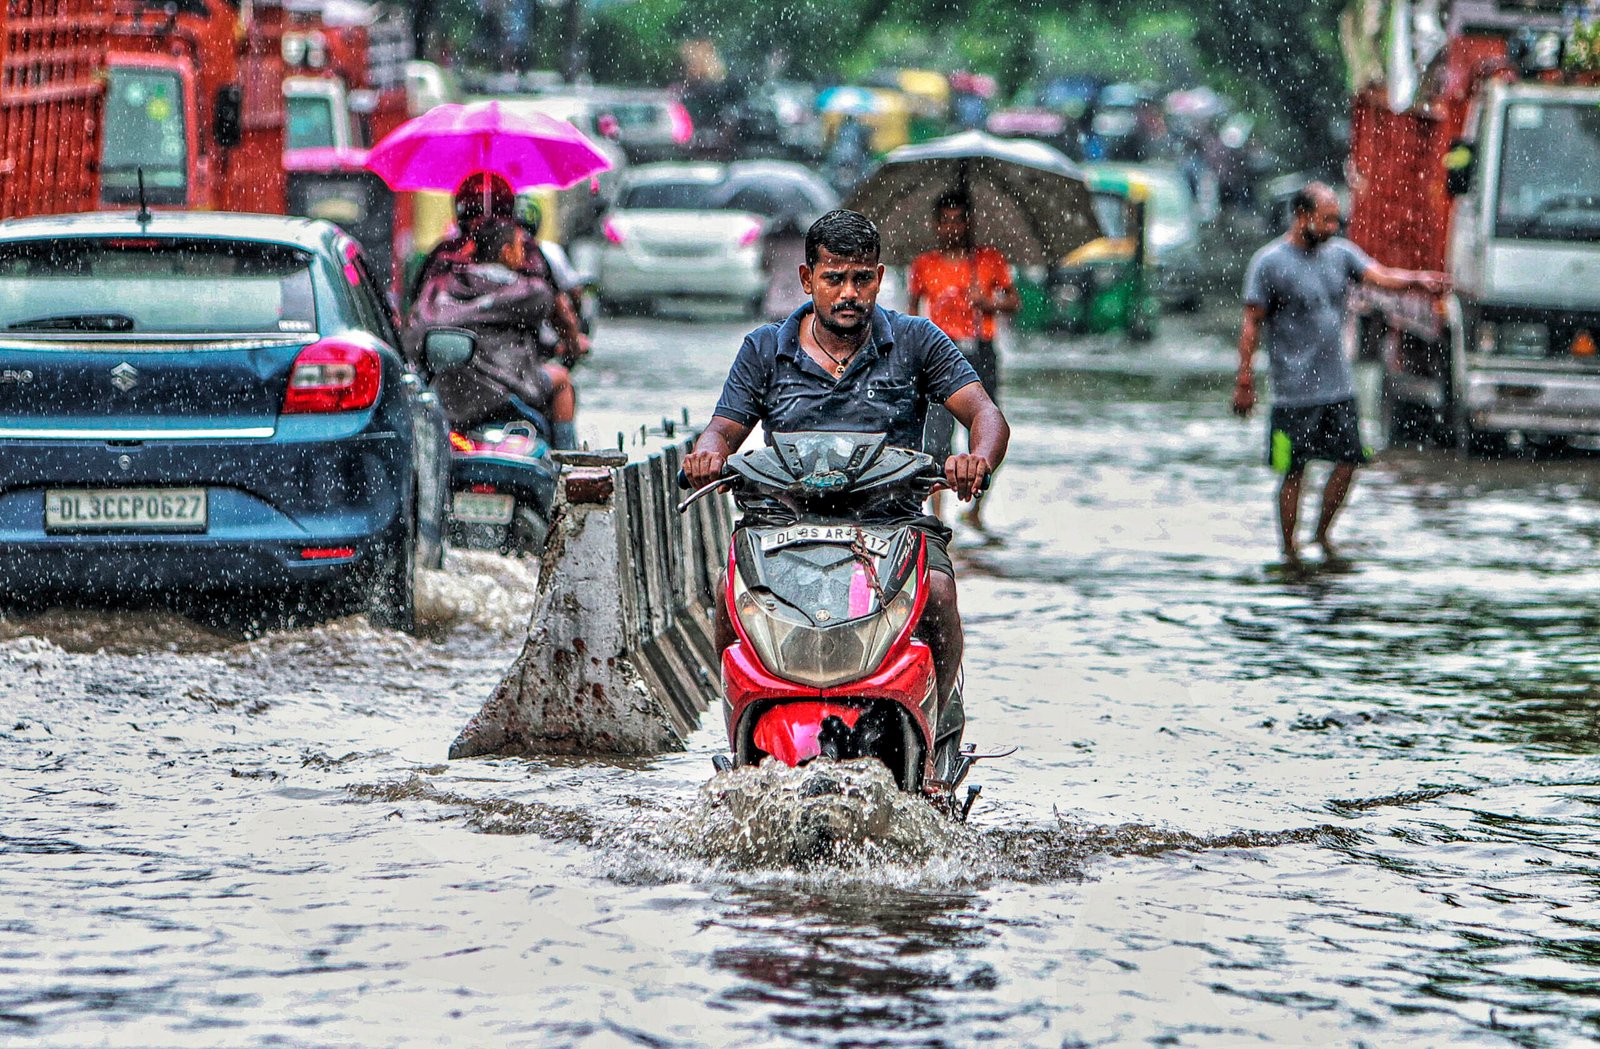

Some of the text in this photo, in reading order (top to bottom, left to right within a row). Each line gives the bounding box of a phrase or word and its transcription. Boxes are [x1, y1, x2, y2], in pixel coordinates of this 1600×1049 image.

[60, 495, 201, 520] DL3CCP0627
[777, 531, 793, 545] DL
[825, 528, 844, 539] AR
